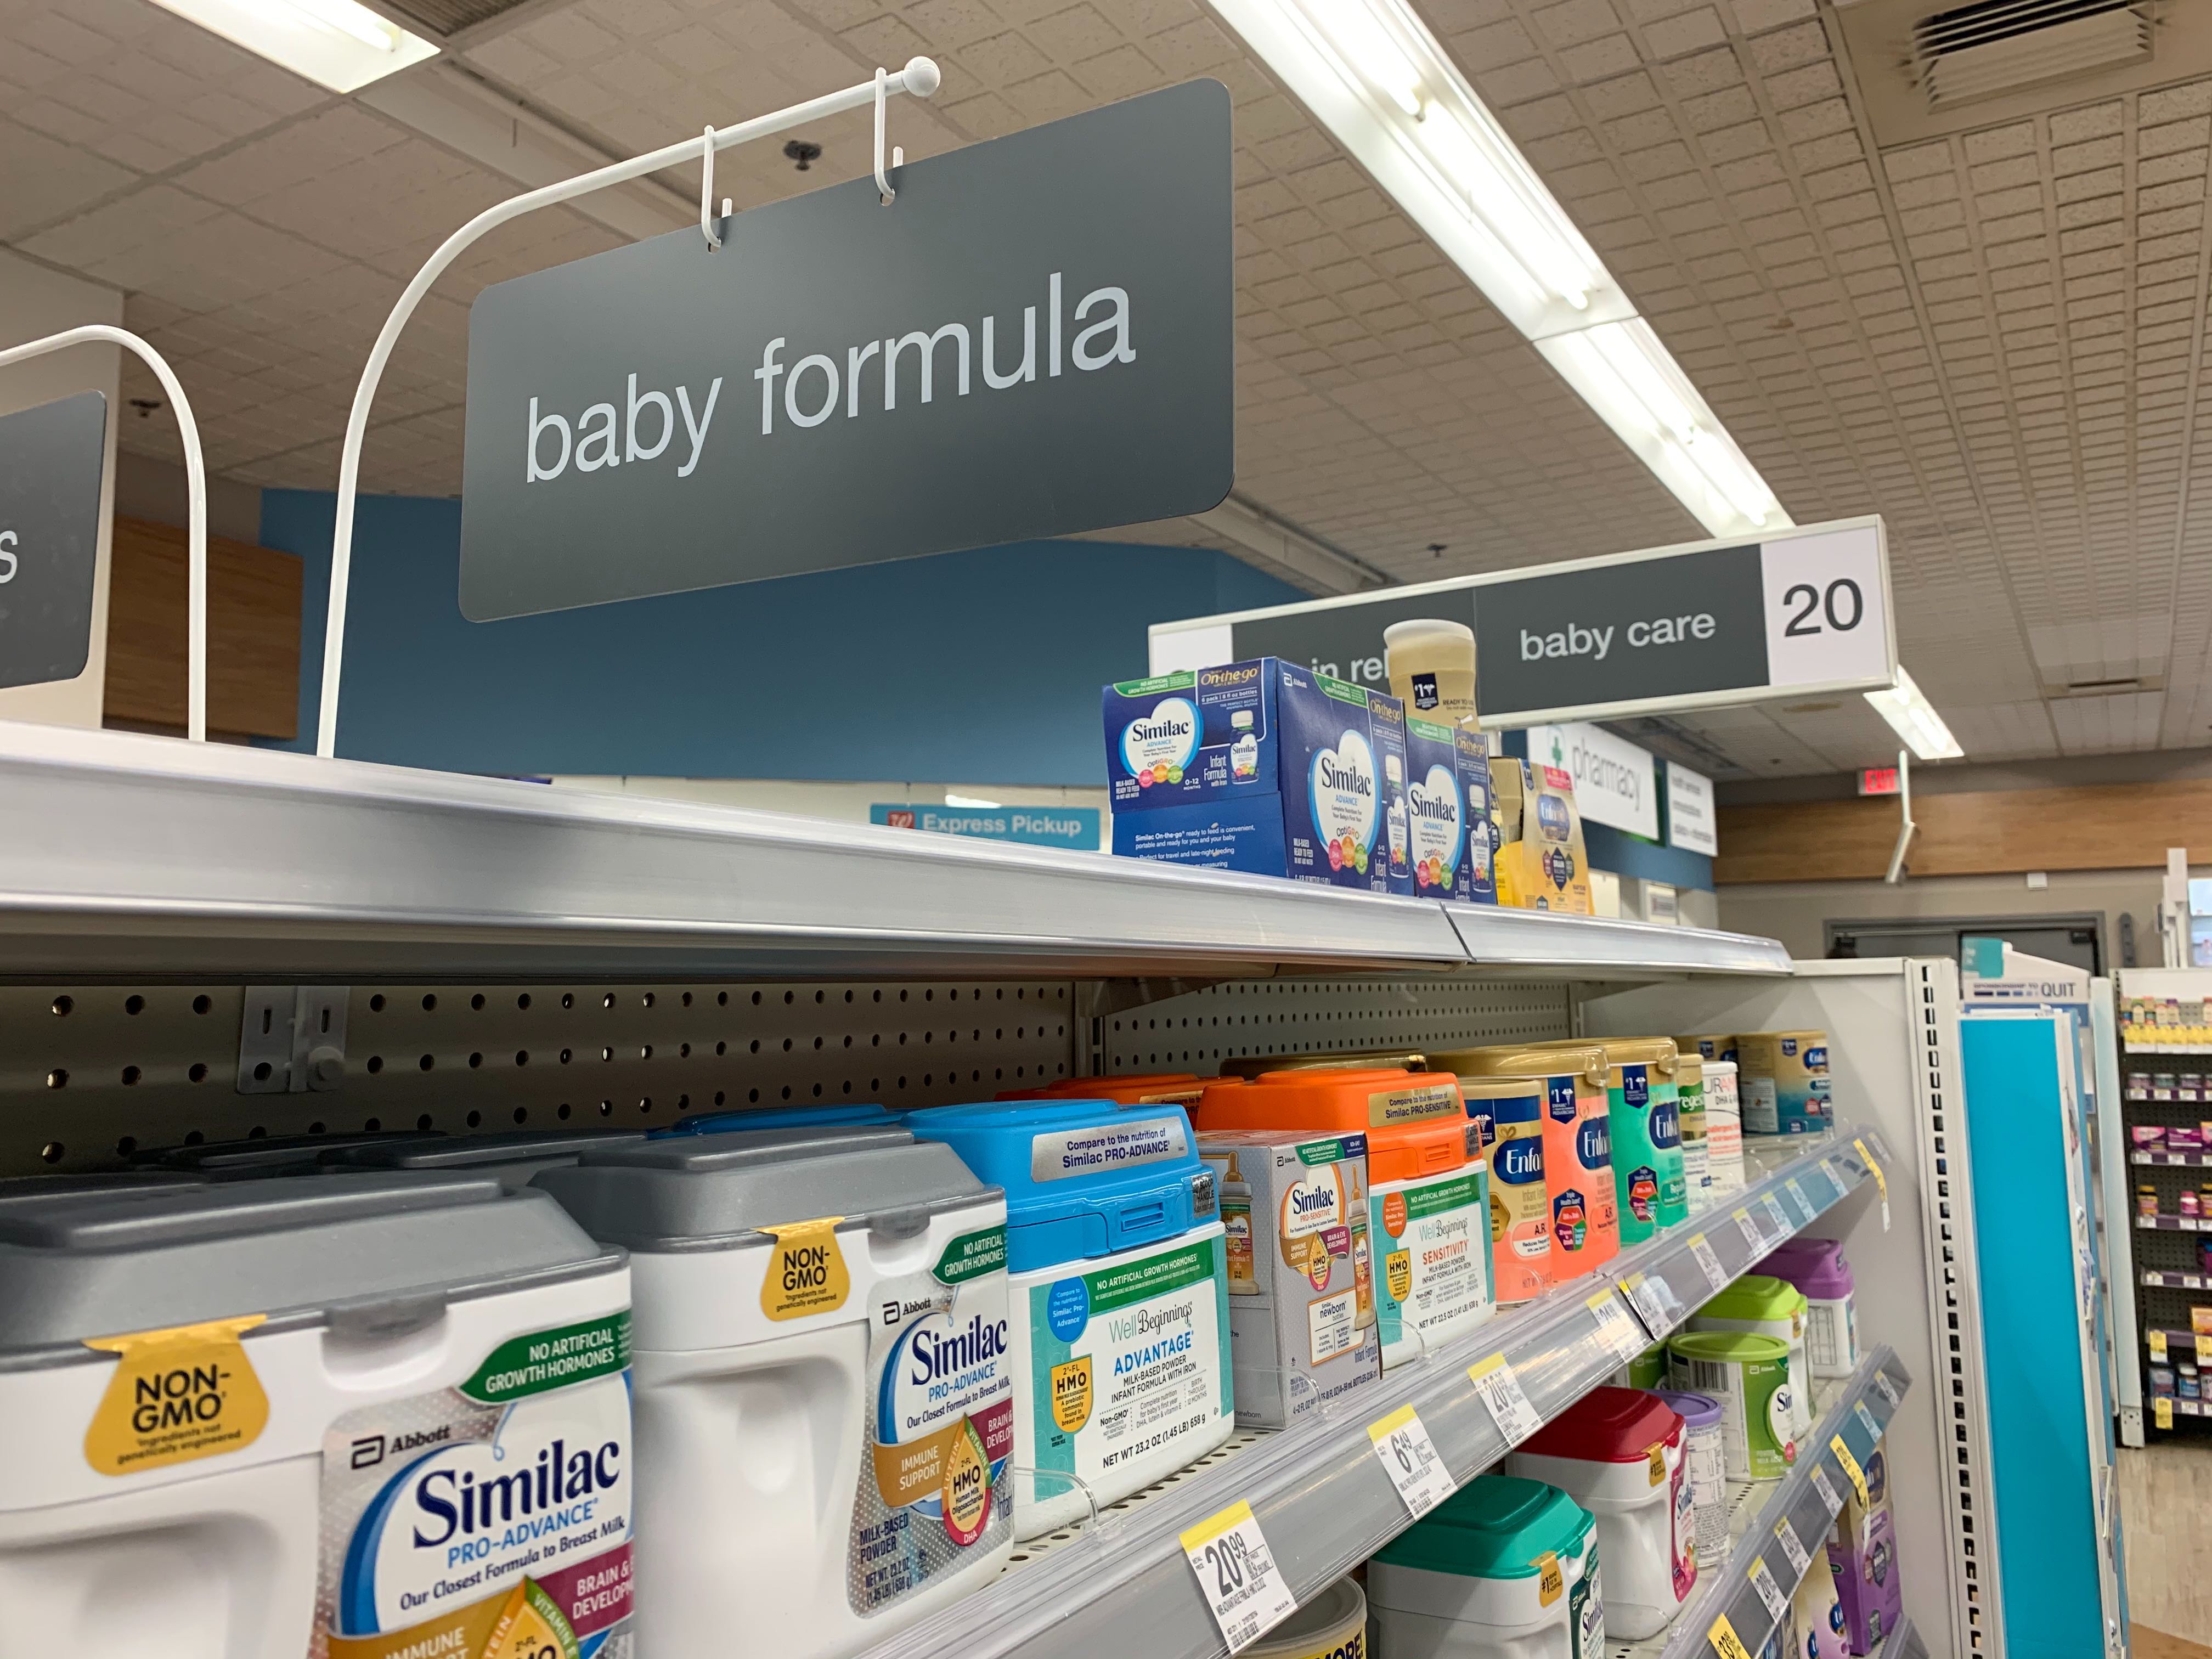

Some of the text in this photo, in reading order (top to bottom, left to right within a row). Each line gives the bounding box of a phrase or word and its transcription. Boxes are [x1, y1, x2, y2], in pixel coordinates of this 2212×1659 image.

[527, 272, 1137, 483] baby formula
[1783, 579, 1863, 638] 20
[1520, 612, 1716, 662] baby care
[1133, 720, 1189, 741] Similac
[1210, 755, 1226, 768] Infant
[1233, 744, 1256, 755] Similac
[1204, 768, 1227, 781] Formula
[1322, 758, 1371, 797] Similac
[1573, 738, 1641, 811] pharmacy
[1865, 769, 1895, 793] EXIT
[1411, 790, 1455, 822] Similac
[924, 814, 1081, 836] Express Pickup
[1136, 841, 1155, 850] portable
[1167, 838, 1180, 847] ready
[1211, 836, 1221, 844] your
[2042, 983, 2075, 997] QUIT
[1386, 1108, 1409, 1119] Similac
[1107, 1137, 1115, 1145] to
[1117, 1134, 1129, 1143] the
[1131, 1128, 1159, 1142] nutrition
[1160, 1128, 1166, 1137] of
[1063, 1152, 1102, 1168] Similac
[1293, 1186, 1334, 1215] Similac
[963, 1234, 1003, 1255] NO ARTIFICIAL
[1419, 1223, 1436, 1242] Well
[783, 1245, 830, 1271] NON-
[1291, 1242, 1306, 1252] IMMUNE
[1291, 1249, 1308, 1260] SUPPORT
[1423, 1240, 1469, 1265] SENSITIVITY
[945, 1248, 1004, 1277] GROWTH HORMONES
[1097, 1280, 1107, 1291] NO
[1109, 1272, 1142, 1288] ARTIFICIAL
[1144, 1265, 1169, 1280] GROWTH
[1170, 1255, 1197, 1272] HORMONES
[1313, 1256, 1325, 1267] HMO
[1390, 1260, 1407, 1274] HMO
[903, 1298, 931, 1315] Abbott
[1053, 1308, 1072, 1318] Similac
[1320, 1303, 1345, 1318] newborn
[1109, 1314, 1136, 1343] Well
[529, 1328, 614, 1362] NO ARTIFICIAL
[912, 1314, 1007, 1386] Similac
[486, 1346, 614, 1393] GROWTH HORMONES
[1057, 1372, 1086, 1393] HMO
[1111, 1362, 1196, 1403] INFANT FORMULA WITH IRON
[1123, 1355, 1186, 1387] MILK-BASED POWDER
[136, 1364, 230, 1404] NON-
[907, 1378, 1010, 1429] Our Closest Formula to Breast Milk
[1235, 1410, 1261, 1418] newborn
[988, 1416, 1007, 1432] BRAIN
[390, 1425, 450, 1454] Abbott
[1103, 1414, 1205, 1468] NET WT 23.2 OZ (1.45 LB) 658 g
[901, 1445, 939, 1472] IMMUNE
[944, 1442, 960, 1491] LUTEIN
[900, 1462, 940, 1491] SUPPORT
[953, 1465, 981, 1494] HMO
[414, 1440, 620, 1549] Similac
[860, 1513, 909, 1546] MILK-BASED
[963, 1532, 978, 1544] DHA
[400, 1516, 625, 1611] Our Closest Formula to Breast Milk
[860, 1541, 896, 1564] POWDER
[577, 1565, 630, 1596] BRAIN &
[534, 1594, 572, 1650] VITAMIN
